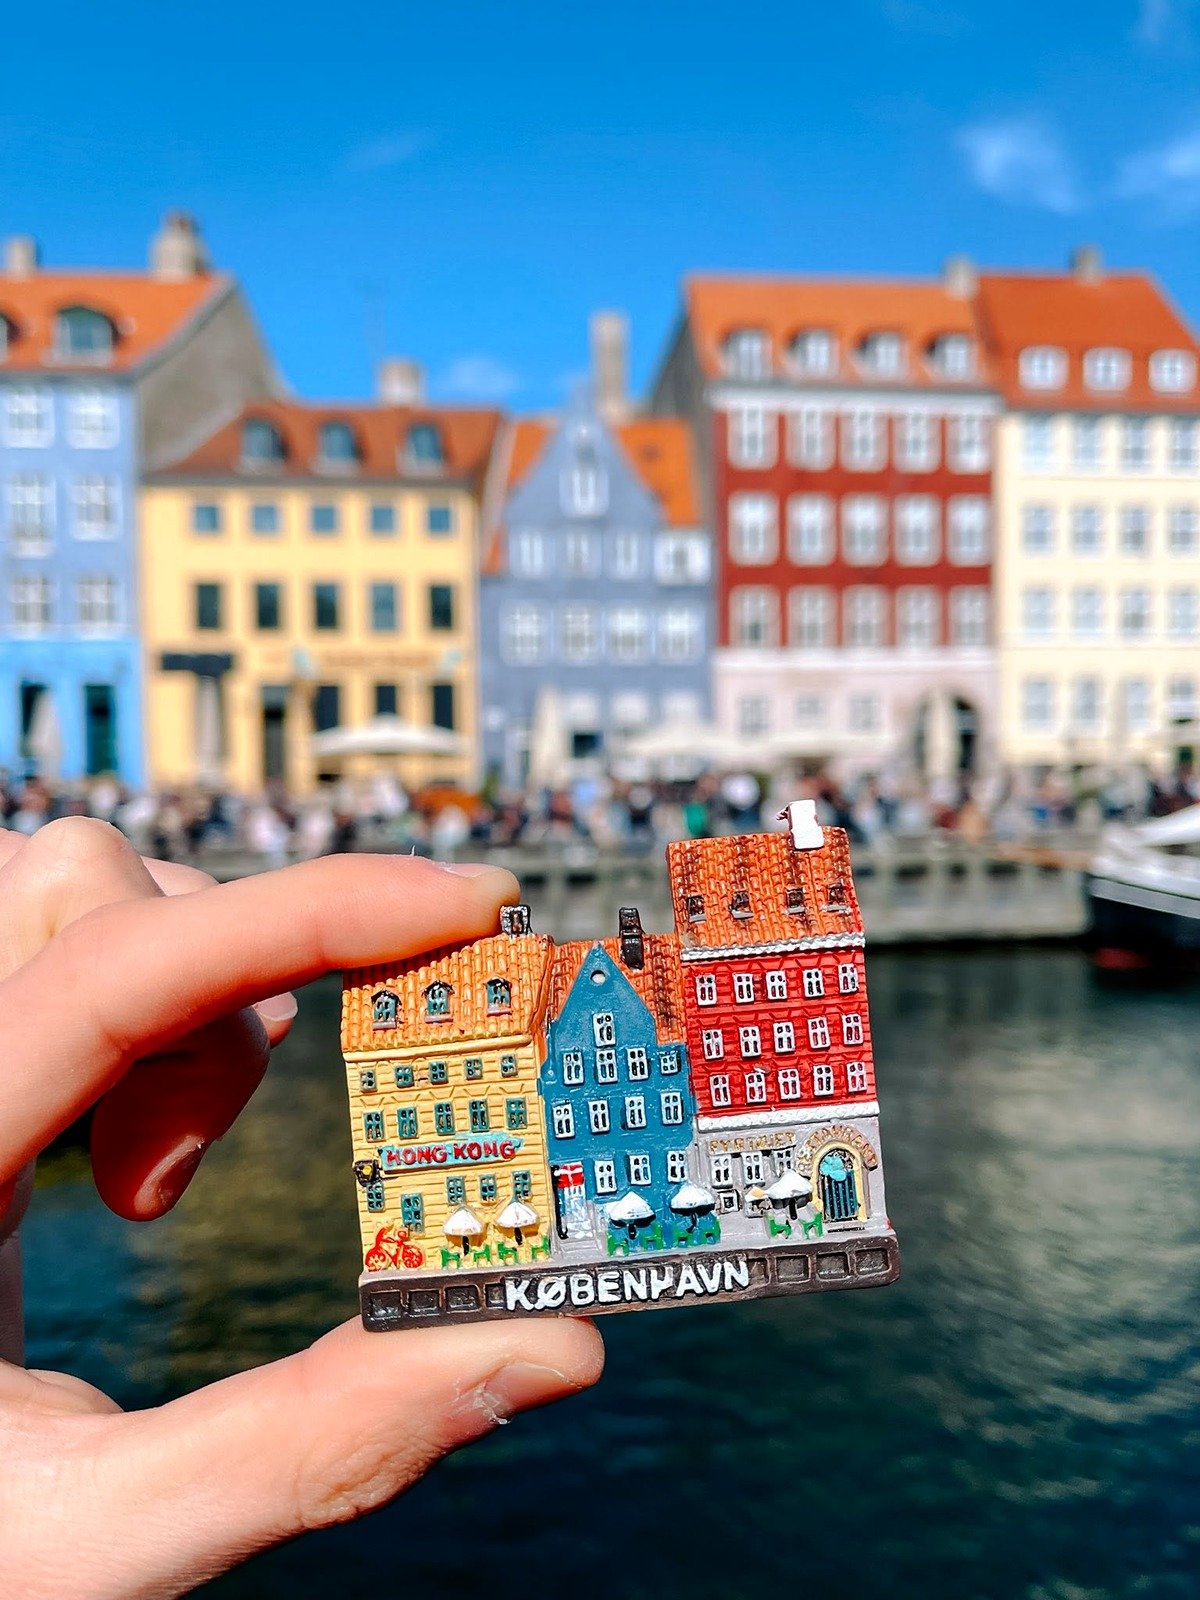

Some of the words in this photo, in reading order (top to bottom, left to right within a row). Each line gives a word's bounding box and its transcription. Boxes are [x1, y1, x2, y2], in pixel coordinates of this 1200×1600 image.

[386, 1145, 448, 1166] HONG
[453, 1140, 516, 1160] KONG
[505, 1260, 750, 1312] KØBENHAVN
